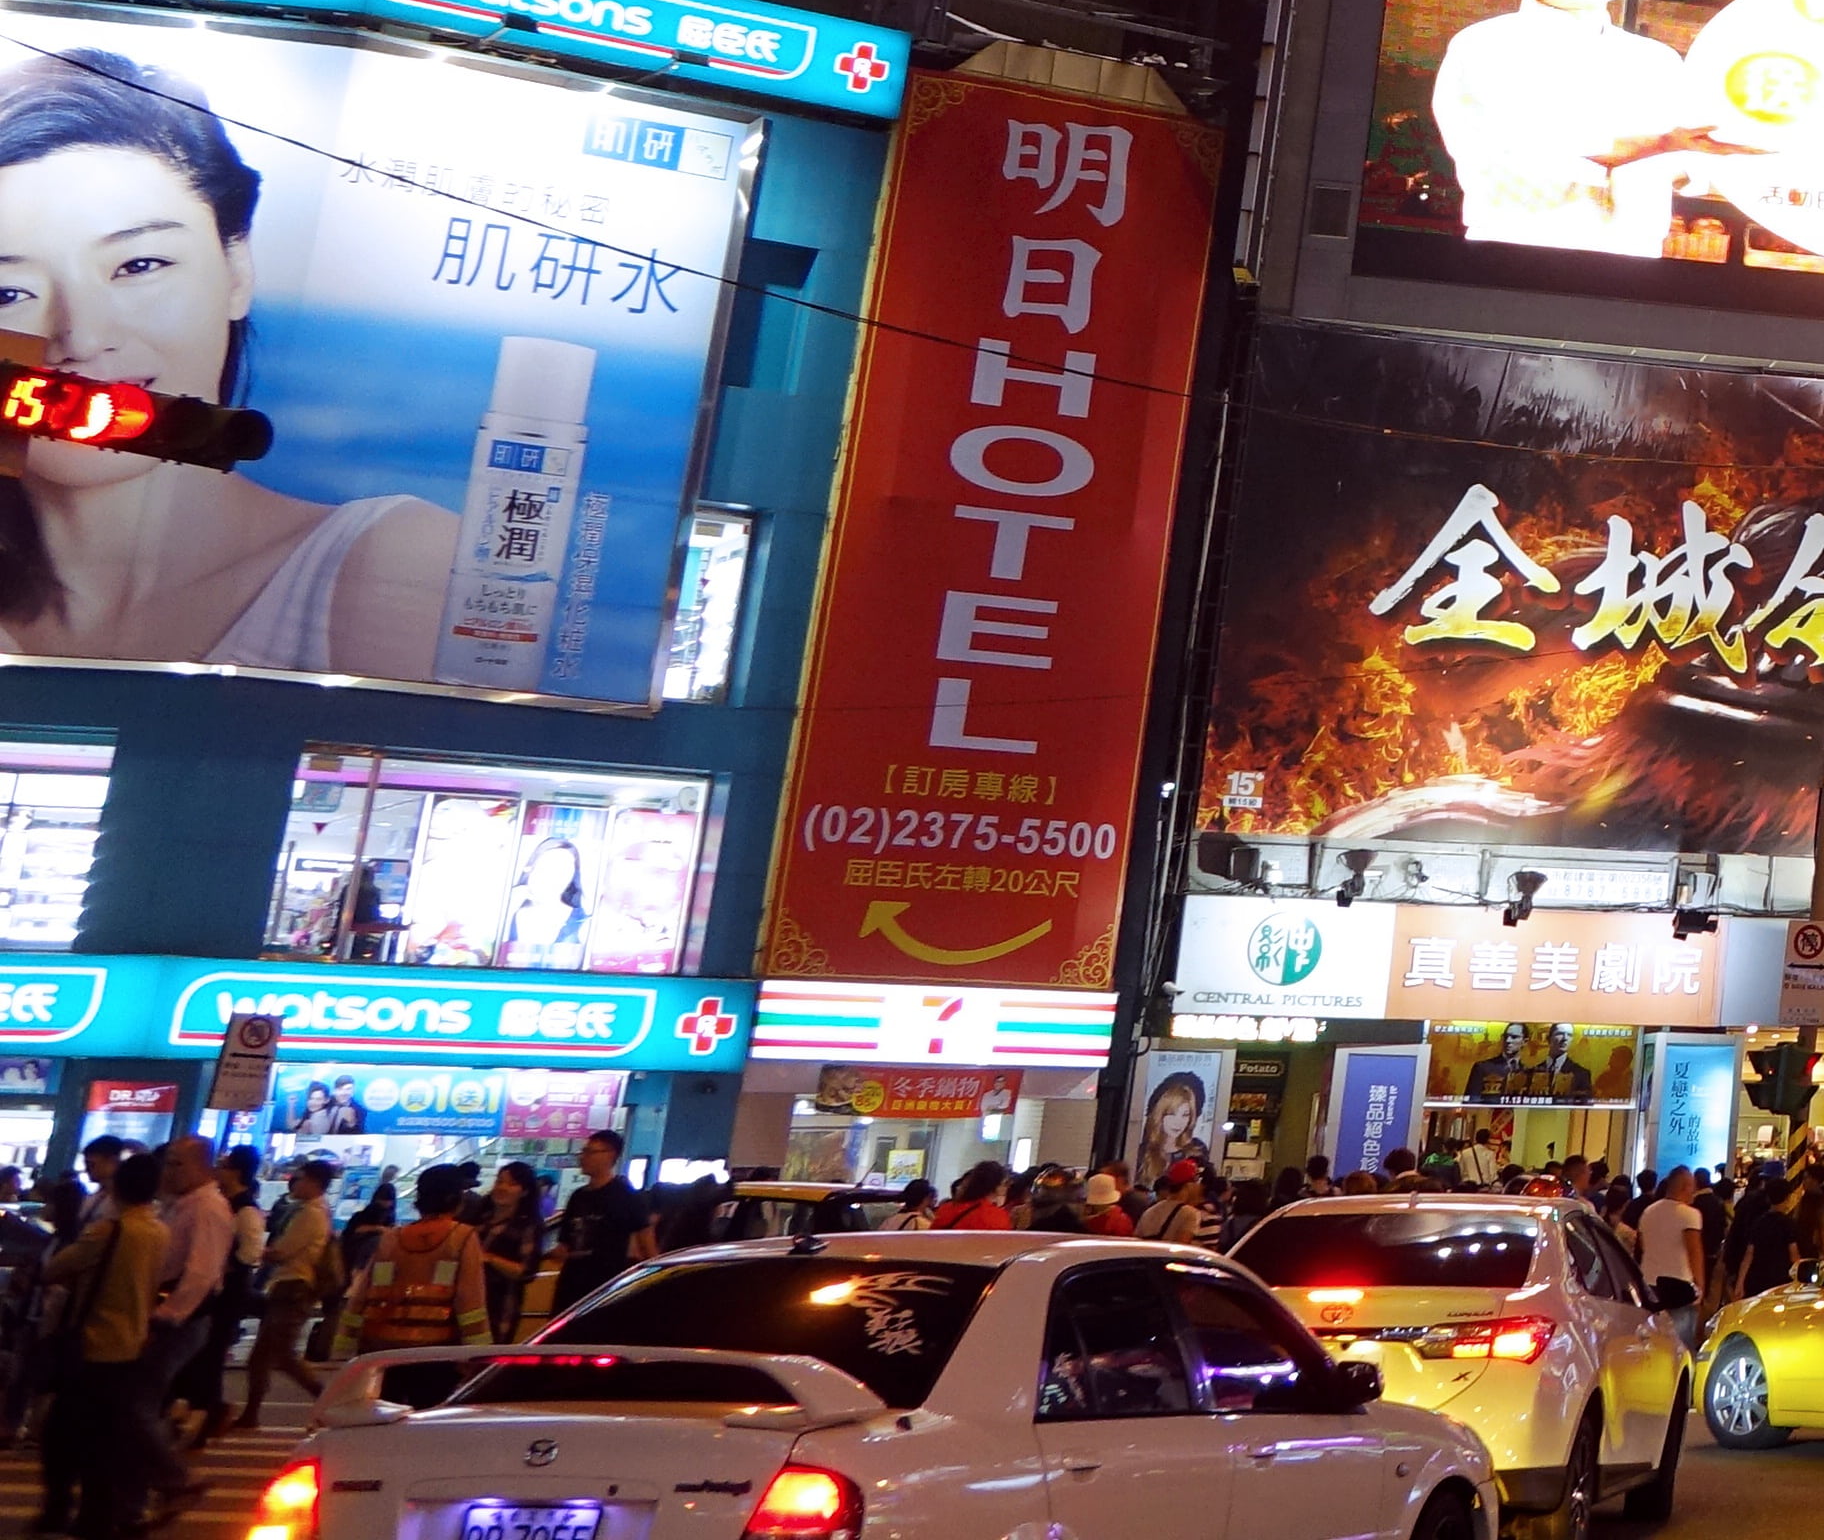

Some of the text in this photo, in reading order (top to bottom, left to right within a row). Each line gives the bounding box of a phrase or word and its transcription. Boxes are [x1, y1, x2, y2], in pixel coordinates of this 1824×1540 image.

[675, 15, 784, 66] 屈臣氏
[340, 152, 611, 225] 水潤肌膚的秘密
[431, 216, 680, 315] 肌研水
[928, 120, 1136, 757] 明日 HOTEL
[493, 488, 549, 563] 極潤
[881, 766, 1061, 806] 【訂房專線】
[803, 800, 1118, 860] (02)2375-5500
[842, 860, 1081, 902] 屈臣氏左轉20公尺
[1402, 935, 1704, 996] 真善美劇院
[496, 996, 620, 1039] 屈臣氏
[1192, 991, 1363, 1008] CENTRAL PICTURES
[1238, 1062, 1279, 1074] Potato
[1668, 1060, 1692, 1137] 夏戀之外
[1686, 1114, 1701, 1157] 的故事
